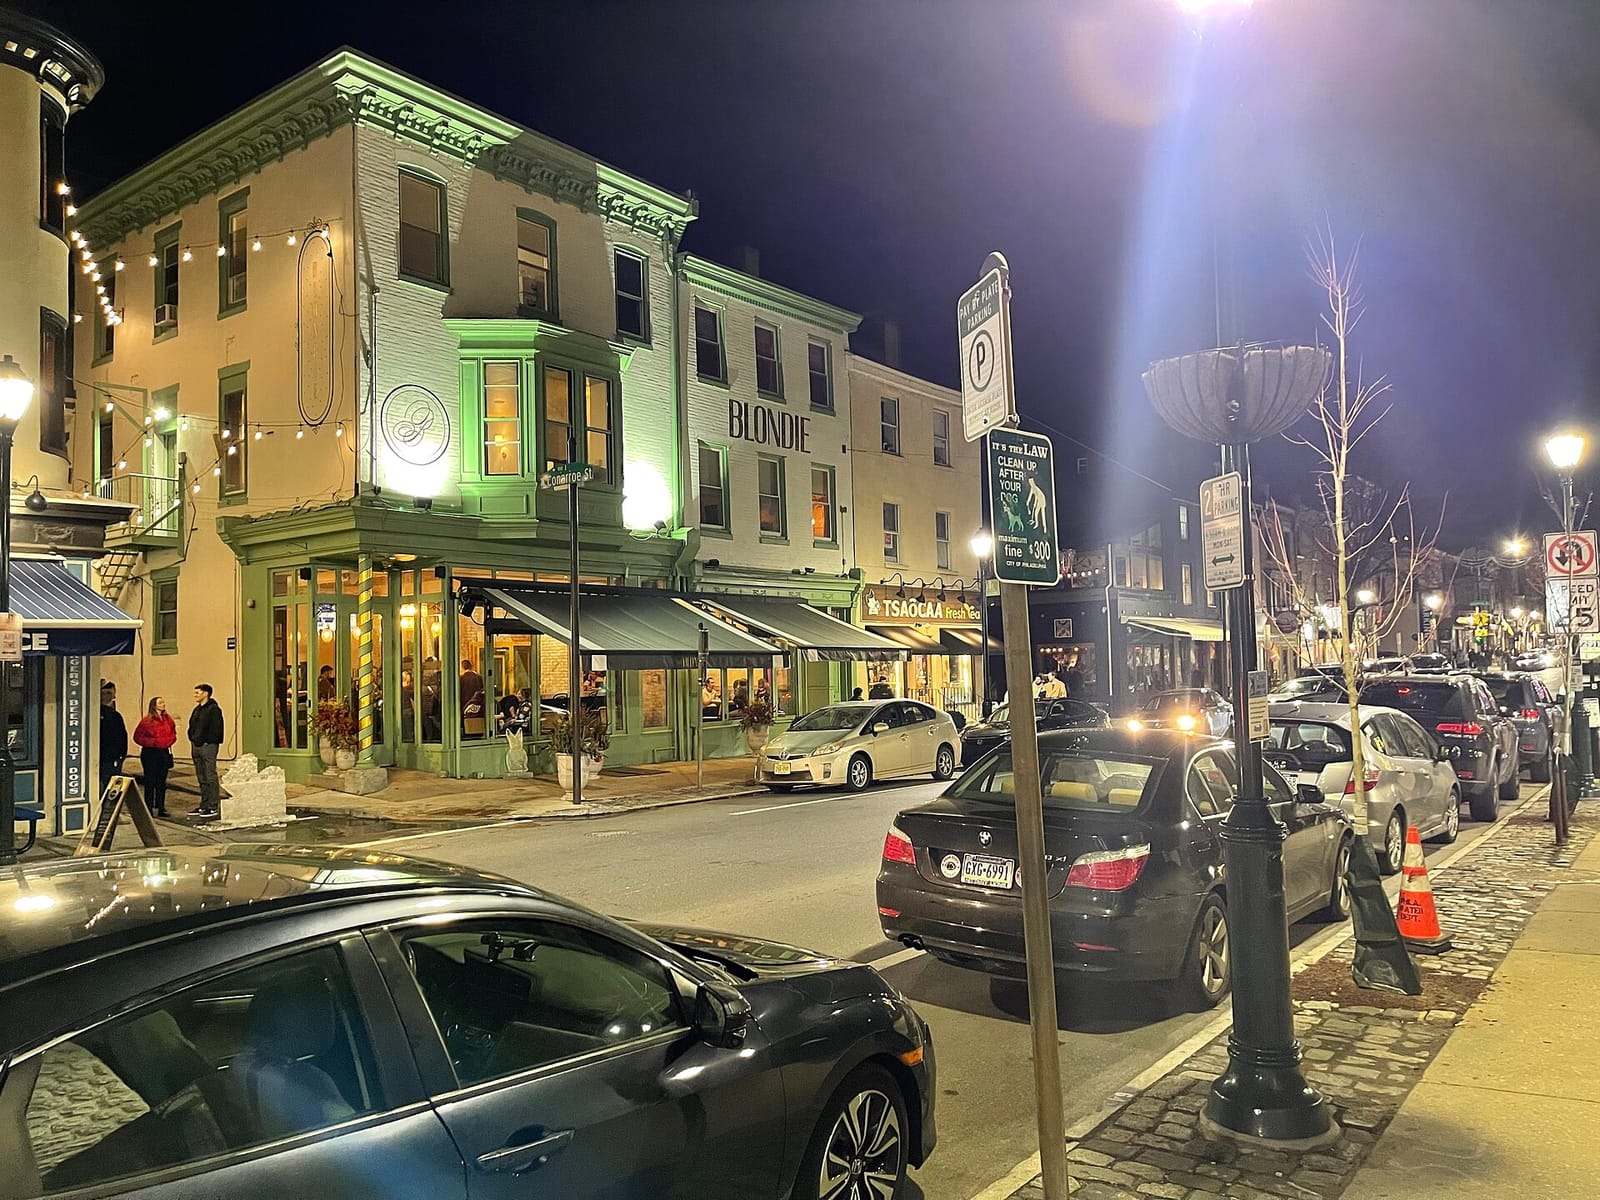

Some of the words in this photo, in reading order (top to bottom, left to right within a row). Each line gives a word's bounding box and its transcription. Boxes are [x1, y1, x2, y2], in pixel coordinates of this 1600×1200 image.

[960, 303, 970, 320] PAY
[981, 279, 998, 303] PLATE
[967, 302, 992, 331] PARKING
[729, 399, 811, 453] BLONDIE
[1009, 445, 1023, 454] THE
[1023, 443, 1048, 459] LAW
[998, 455, 1024, 469] CLEAN
[1027, 460, 1037, 471] UP
[547, 471, 581, 487] Conarroe
[584, 467, 593, 480] St
[999, 468, 1025, 481] AFTER
[1000, 479, 1022, 492] YOUR
[1001, 492, 1019, 503] DOG
[1204, 490, 1212, 516] 2
[1215, 496, 1239, 516] PARKING
[999, 534, 1028, 544] maximum
[1004, 544, 1023, 558] fine
[1554, 584, 1594, 594] PEED
[69, 740, 79, 760] HOT
[69, 767, 79, 795] DOGS
